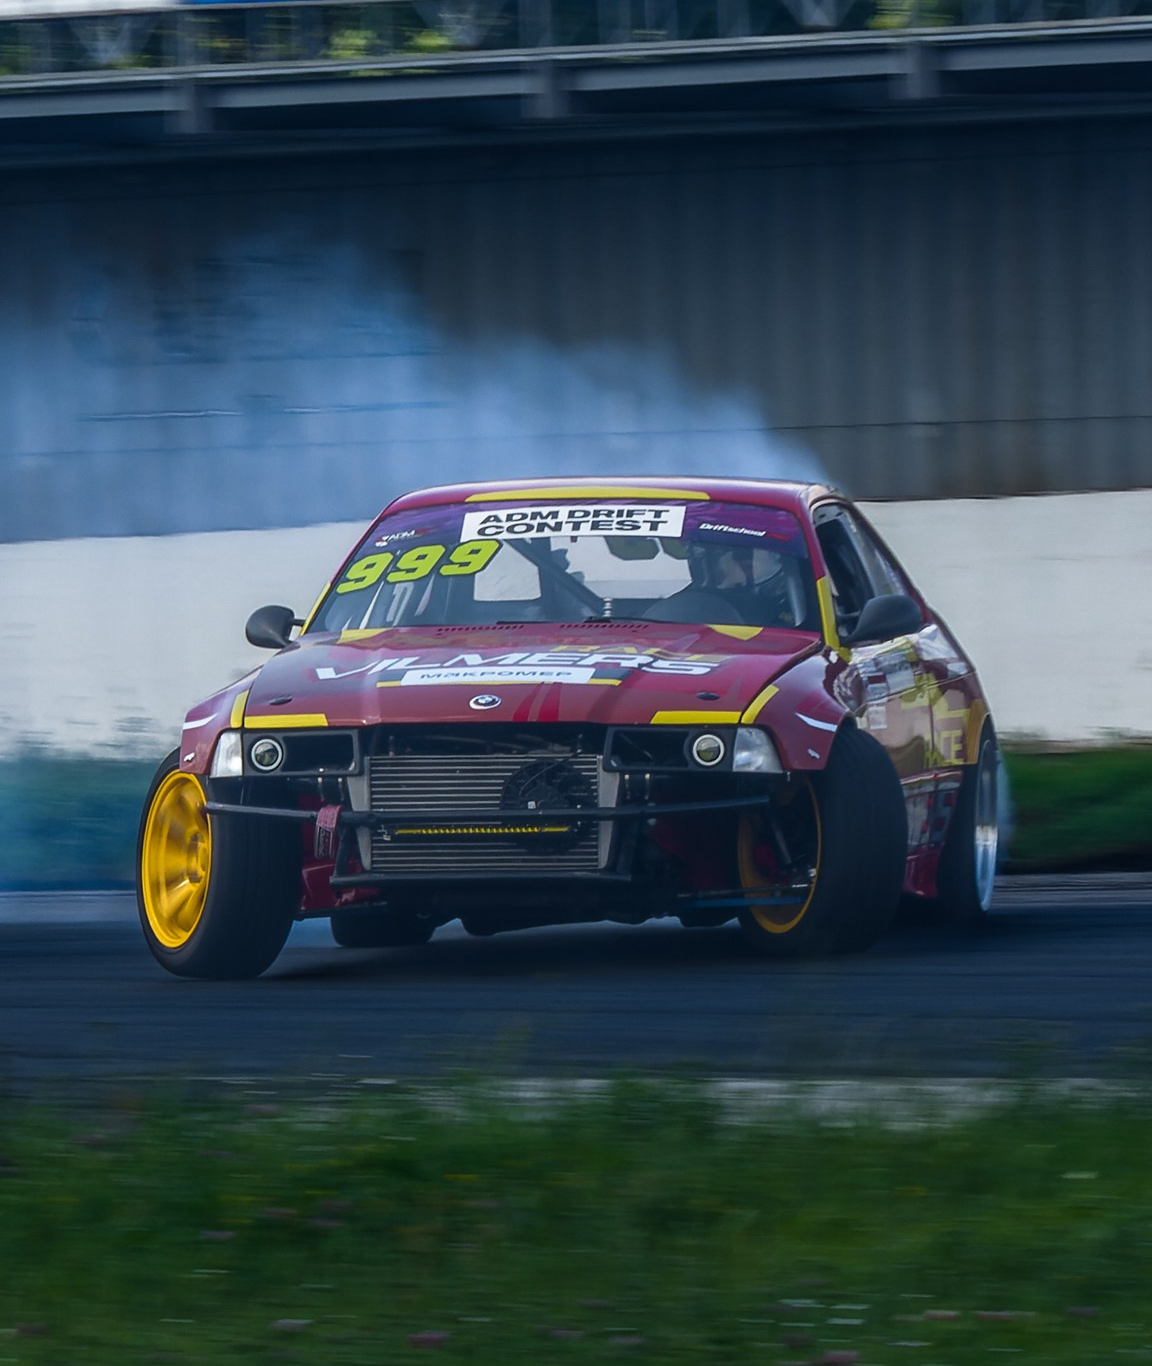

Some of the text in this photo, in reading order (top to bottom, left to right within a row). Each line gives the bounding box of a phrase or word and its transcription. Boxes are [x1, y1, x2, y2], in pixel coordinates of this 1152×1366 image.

[477, 519, 668, 536] CONTEST
[479, 509, 670, 524] ADM DRIFT
[336, 539, 501, 594] 999
[315, 652, 721, 681] VILMERS
